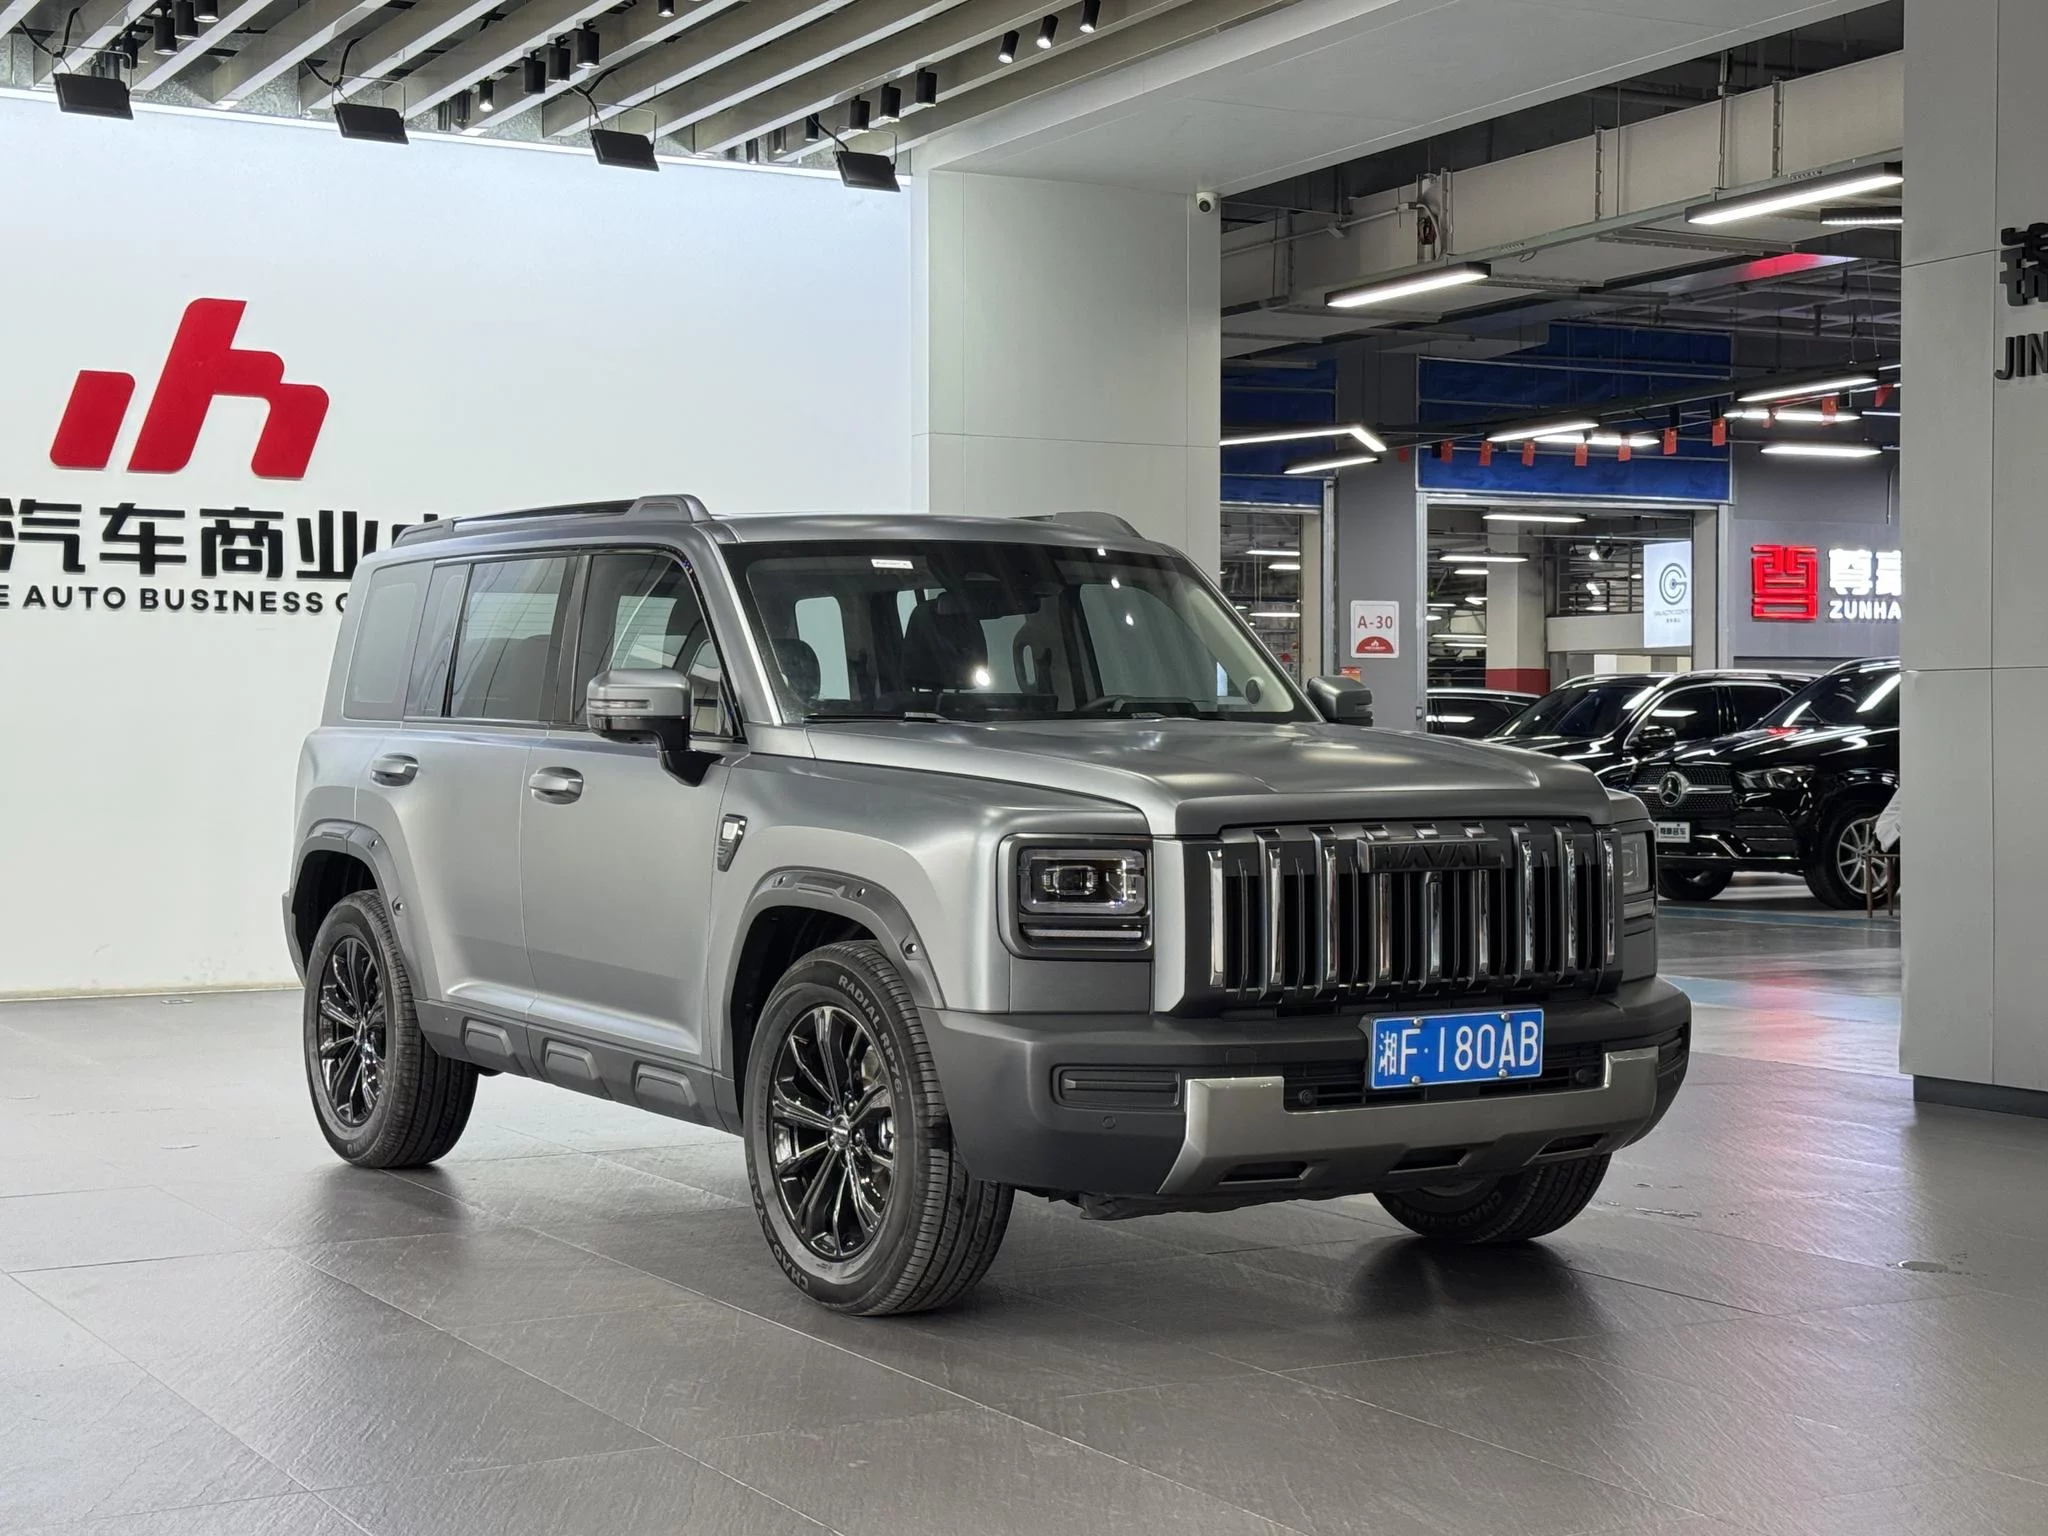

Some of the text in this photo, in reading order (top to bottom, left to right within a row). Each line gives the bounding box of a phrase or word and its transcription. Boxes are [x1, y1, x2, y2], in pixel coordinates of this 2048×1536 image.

[0, 497, 437, 580] 汽车商业
[23, 585, 126, 611] AUTO
[140, 587, 323, 614] BUSINESS
[1357, 615, 1393, 629] A-30
[1372, 843, 1497, 869] HAVAL
[838, 975, 880, 1030] RADIAL
